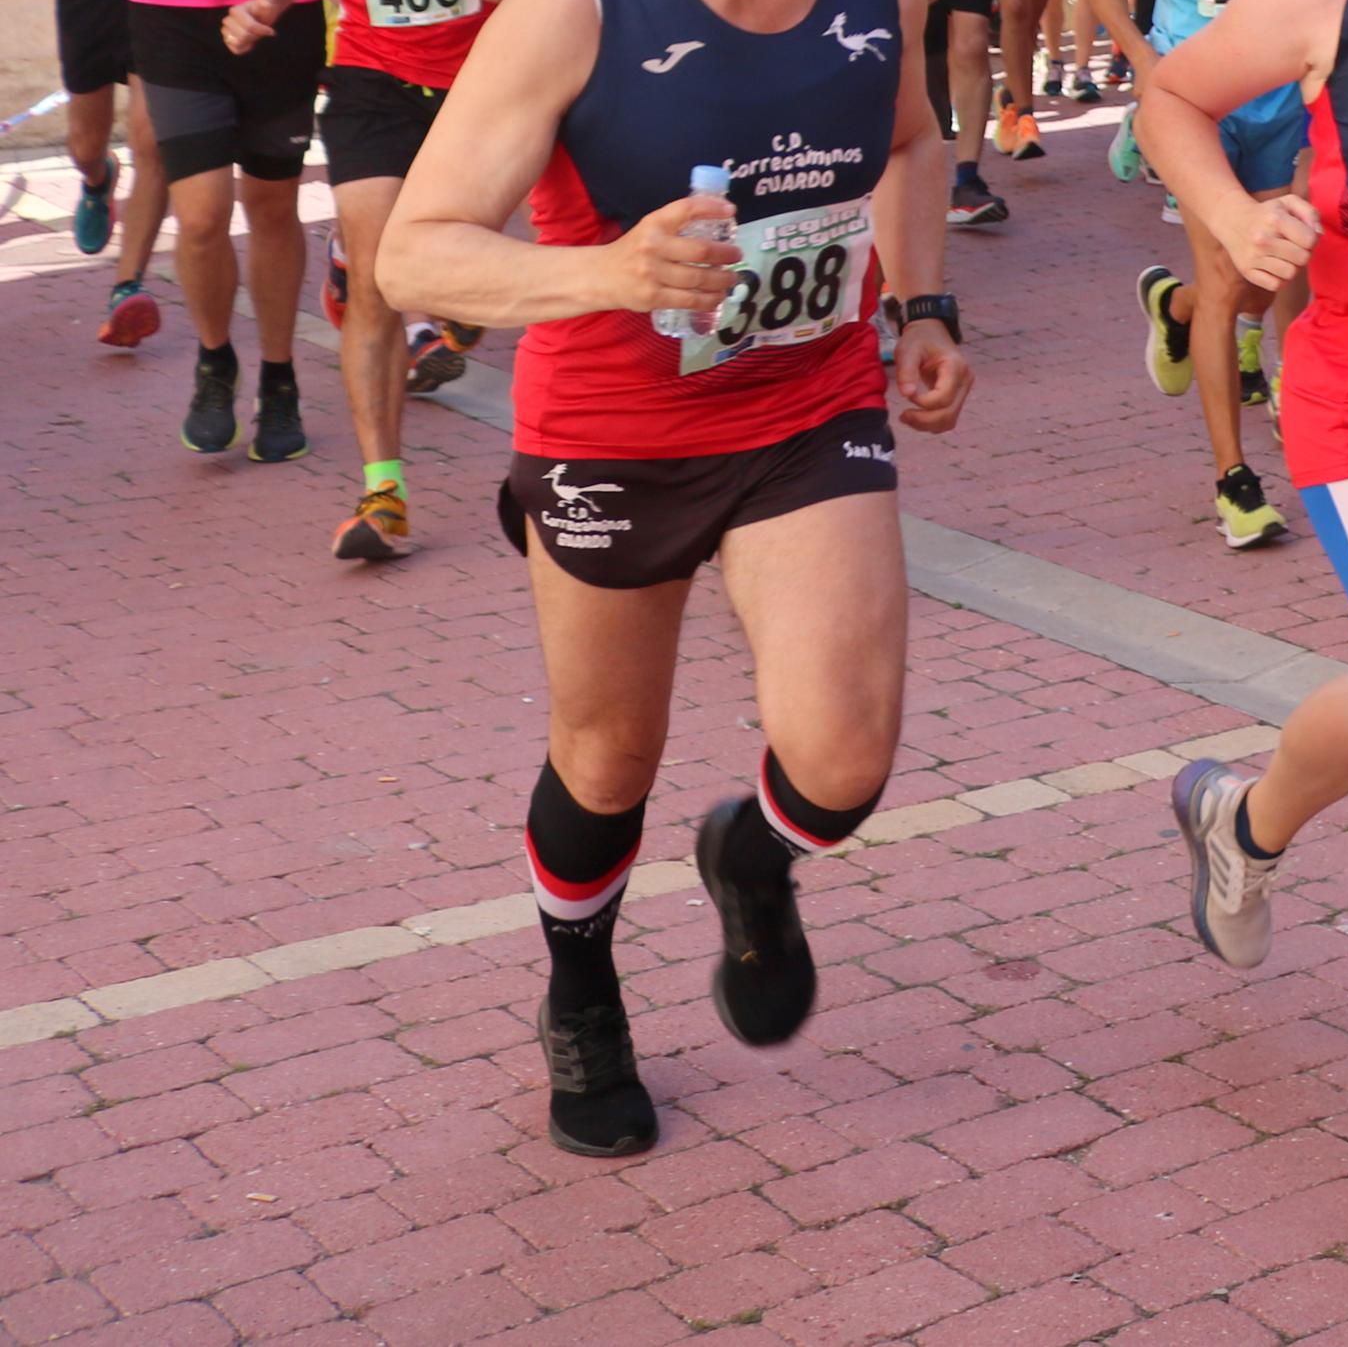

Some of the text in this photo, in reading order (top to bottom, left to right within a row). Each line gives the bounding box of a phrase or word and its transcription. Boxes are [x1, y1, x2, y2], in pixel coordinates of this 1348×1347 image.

[771, 132, 811, 152] C.D.
[754, 169, 836, 197] GUARDO
[717, 244, 848, 346] 388
